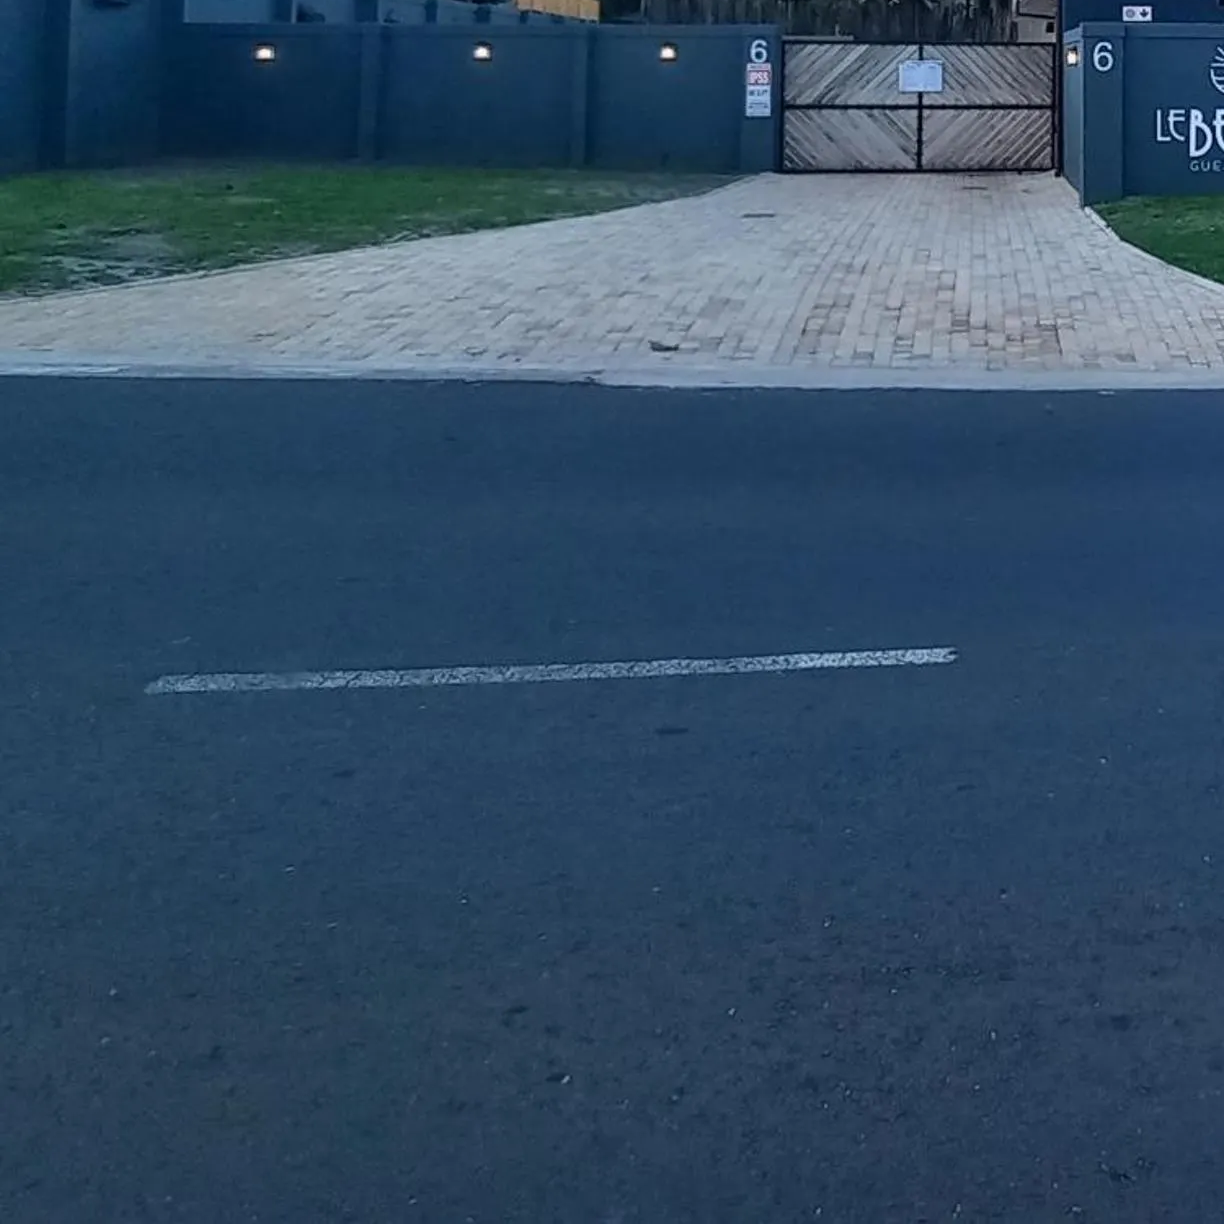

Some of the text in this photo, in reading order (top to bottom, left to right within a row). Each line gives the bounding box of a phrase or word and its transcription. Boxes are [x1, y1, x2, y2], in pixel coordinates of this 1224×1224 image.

[751, 39, 768, 63] 6
[1093, 42, 1113, 72] 6
[1156, 109, 1185, 141] LE
